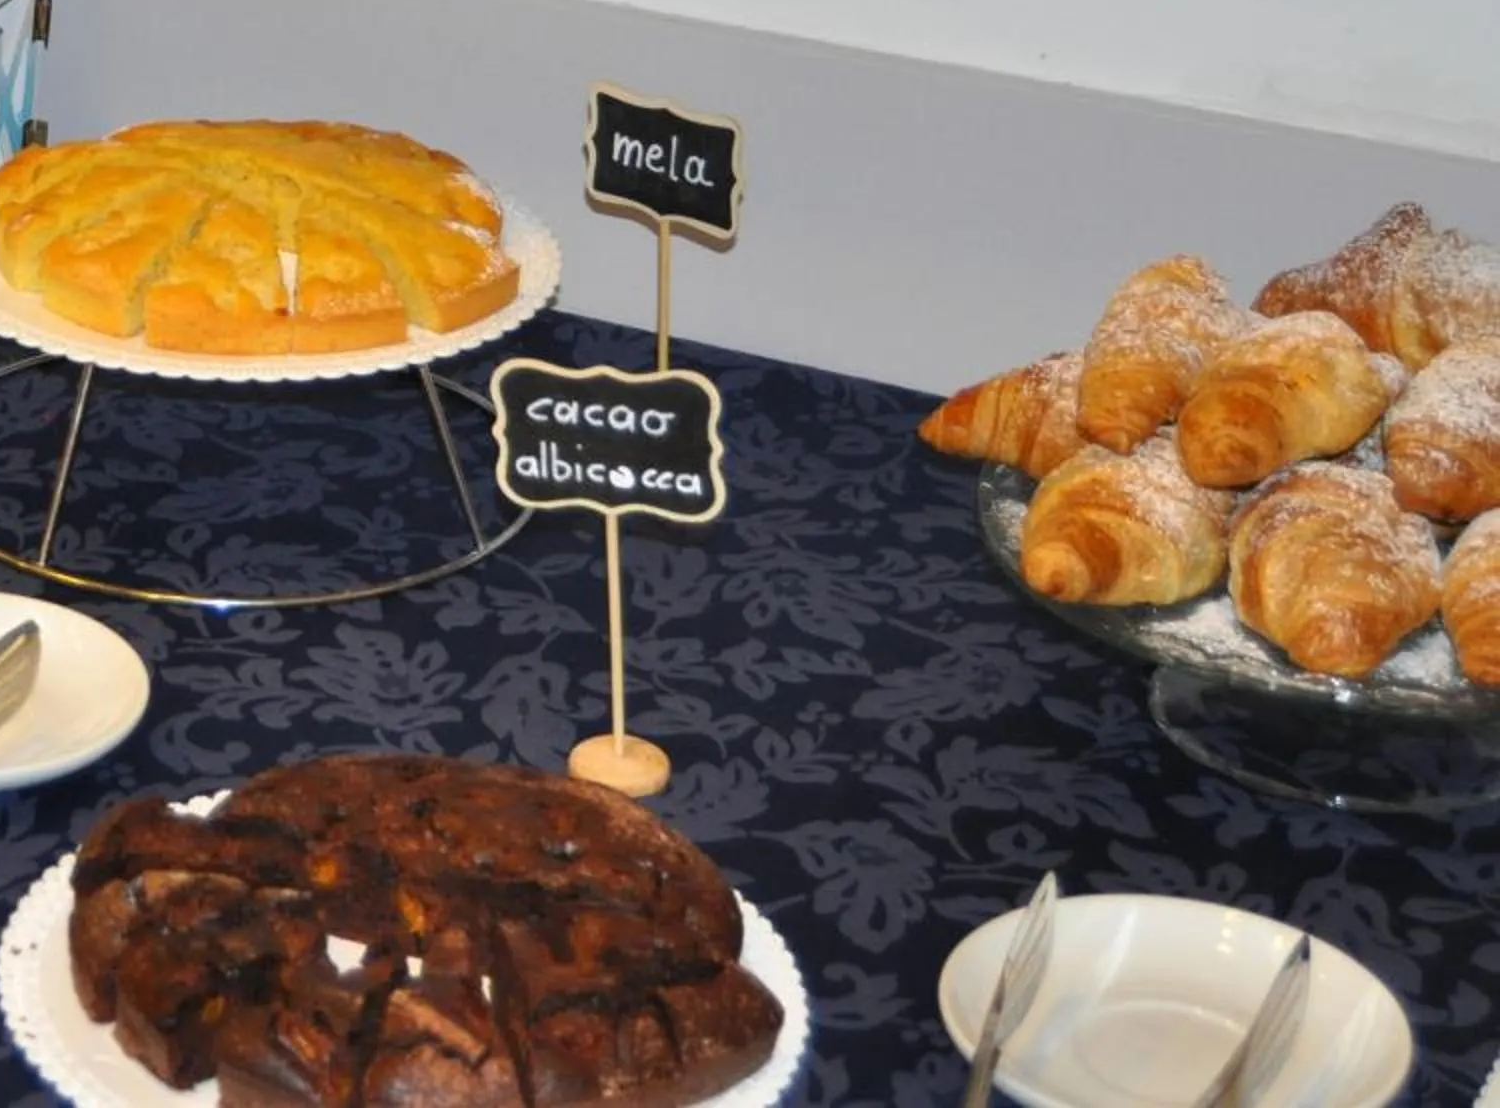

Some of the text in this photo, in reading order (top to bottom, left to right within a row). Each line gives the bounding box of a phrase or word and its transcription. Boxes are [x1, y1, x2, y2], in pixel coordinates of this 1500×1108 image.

[611, 131, 715, 187] mela
[526, 398, 676, 436] cacao
[515, 441, 703, 496] albicocca
